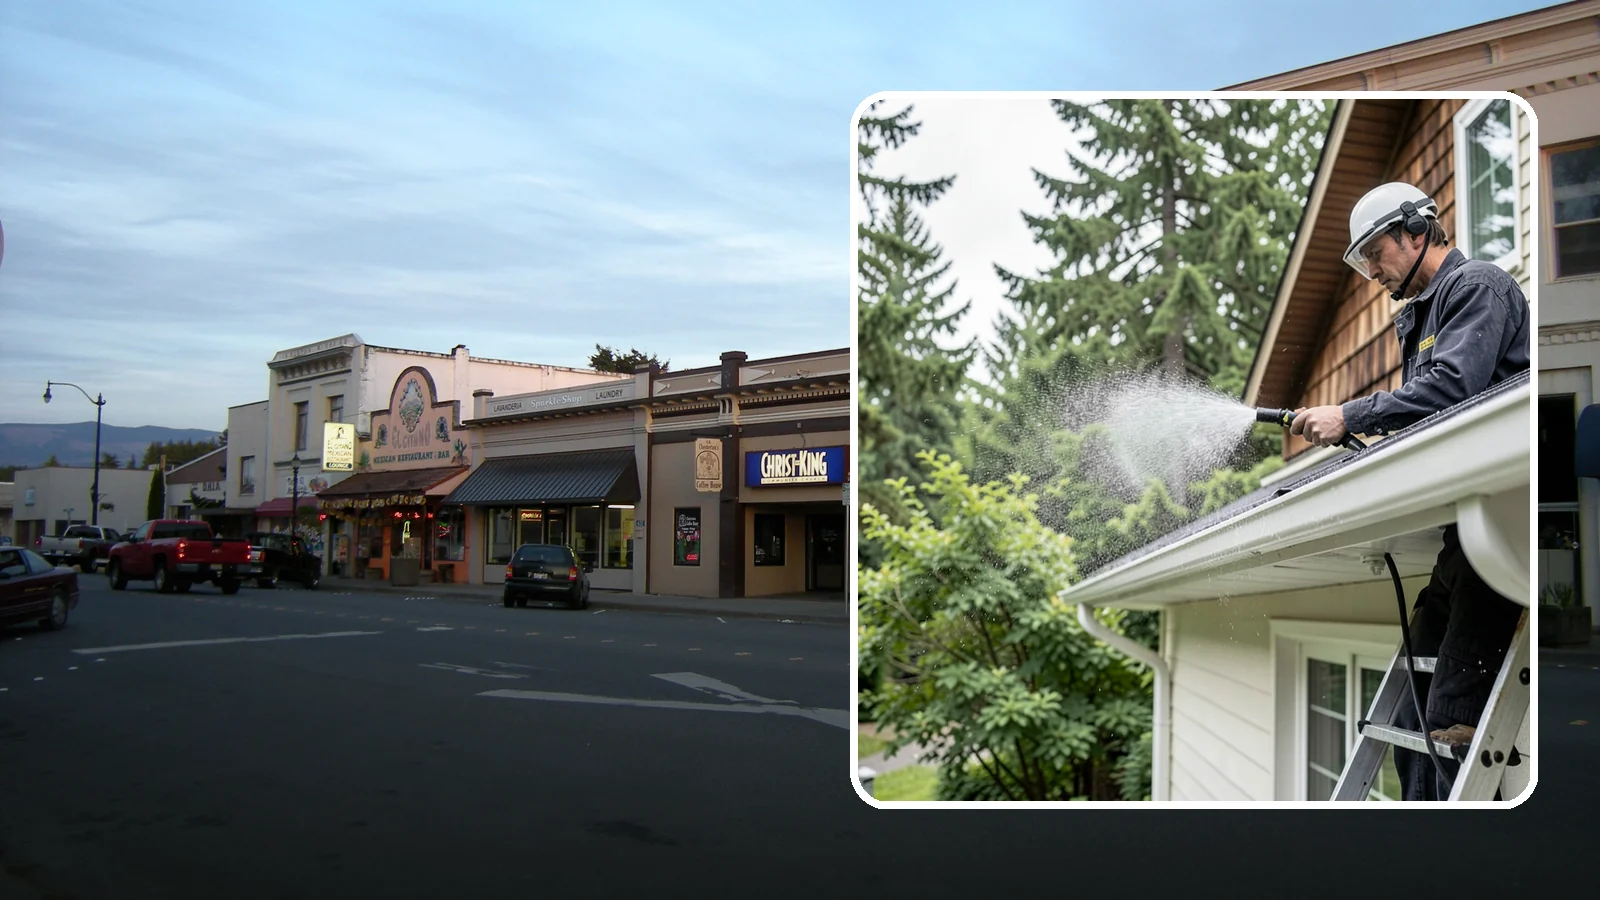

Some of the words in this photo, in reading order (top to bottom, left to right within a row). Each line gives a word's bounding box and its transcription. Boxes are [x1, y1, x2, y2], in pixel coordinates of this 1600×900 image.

[596, 389, 623, 400] LAUNDRY
[494, 402, 523, 413] LAVANDERIA
[531, 397, 561, 409] Sparkle
[562, 394, 582, 405] Shop
[374, 455, 397, 464] MEXICAN
[398, 452, 433, 462] RESTAURANT
[438, 450, 450, 459] BAR
[761, 452, 797, 479] CHRIST
[799, 450, 828, 477] KING
[697, 481, 709, 489] Coffee
